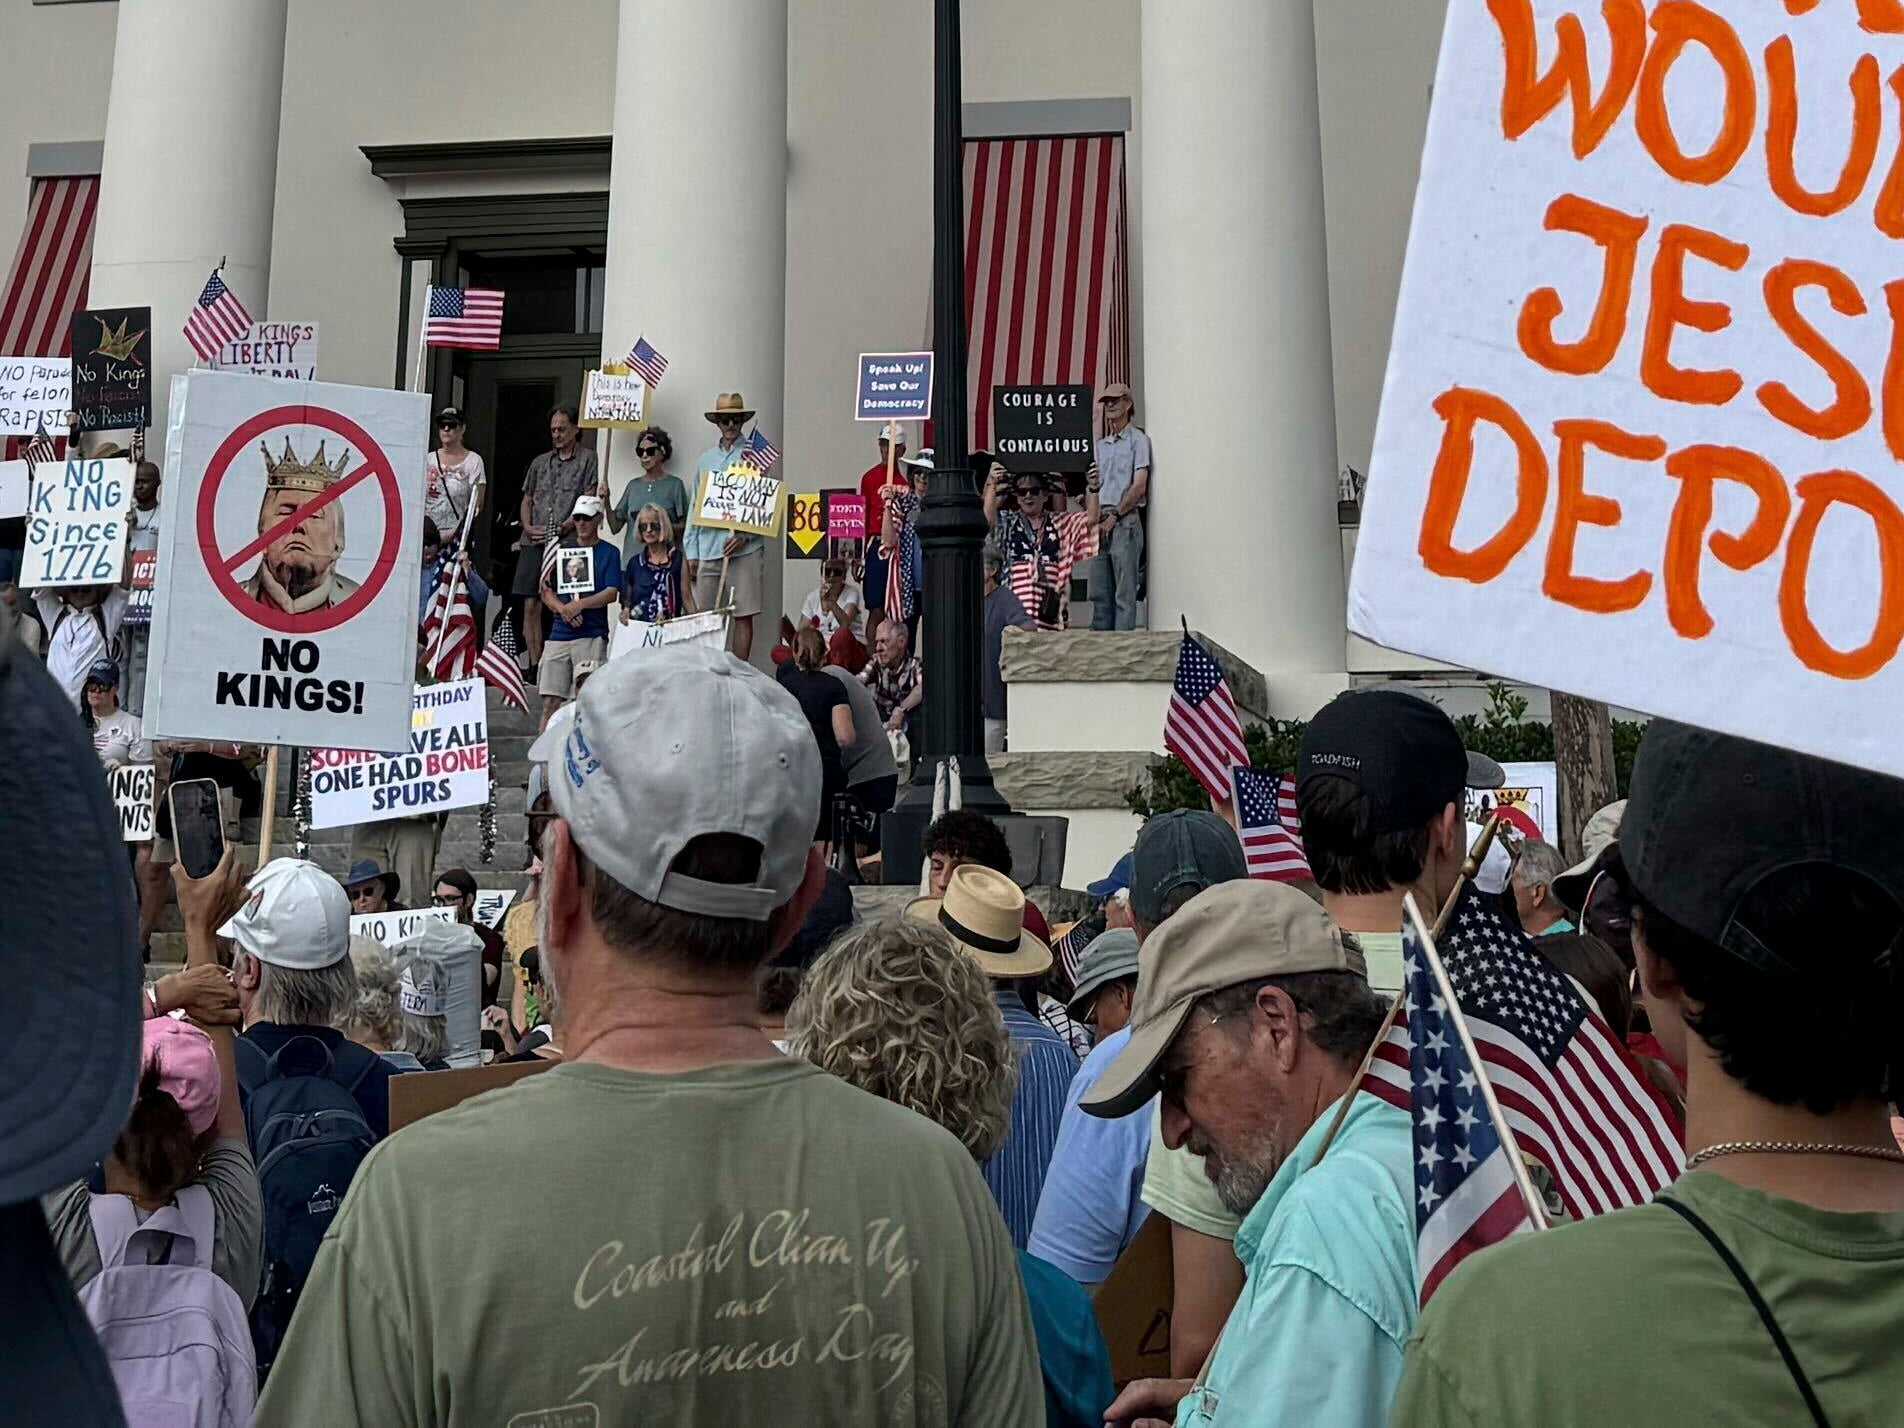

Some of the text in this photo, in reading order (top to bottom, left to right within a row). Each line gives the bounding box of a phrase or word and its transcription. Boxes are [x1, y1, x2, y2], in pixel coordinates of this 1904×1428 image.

[259, 324, 314, 344] KINGS
[220, 341, 297, 365] LIBERTY
[0, 365, 25, 382] NO
[76, 364, 96, 384] No
[868, 363, 924, 376] Speak Up!
[22, 386, 69, 401] felon
[870, 380, 920, 391] Save Our
[863, 398, 925, 410] Democracy
[1002, 392, 1077, 408] COURAGE
[79, 407, 96, 427] No
[1037, 411, 1053, 425] IS
[998, 438, 1089, 453] CONTAGIOUS
[64, 458, 104, 488] NO
[717, 485, 768, 507] IS NOT
[794, 500, 821, 531] 86
[29, 517, 118, 546] Since
[40, 543, 113, 582] 1776
[261, 637, 320, 674] NO
[215, 671, 365, 715] KINGS!
[413, 685, 474, 710] RTHDAY
[445, 722, 487, 747] ALL
[314, 746, 488, 794] ONE HAD BONE
[372, 778, 452, 812] SPURS
[360, 920, 387, 942] NO
[574, 1207, 920, 1310] Coastal Clean Up
[714, 1278, 785, 1320] and
[566, 1303, 914, 1400] Awareness Day
